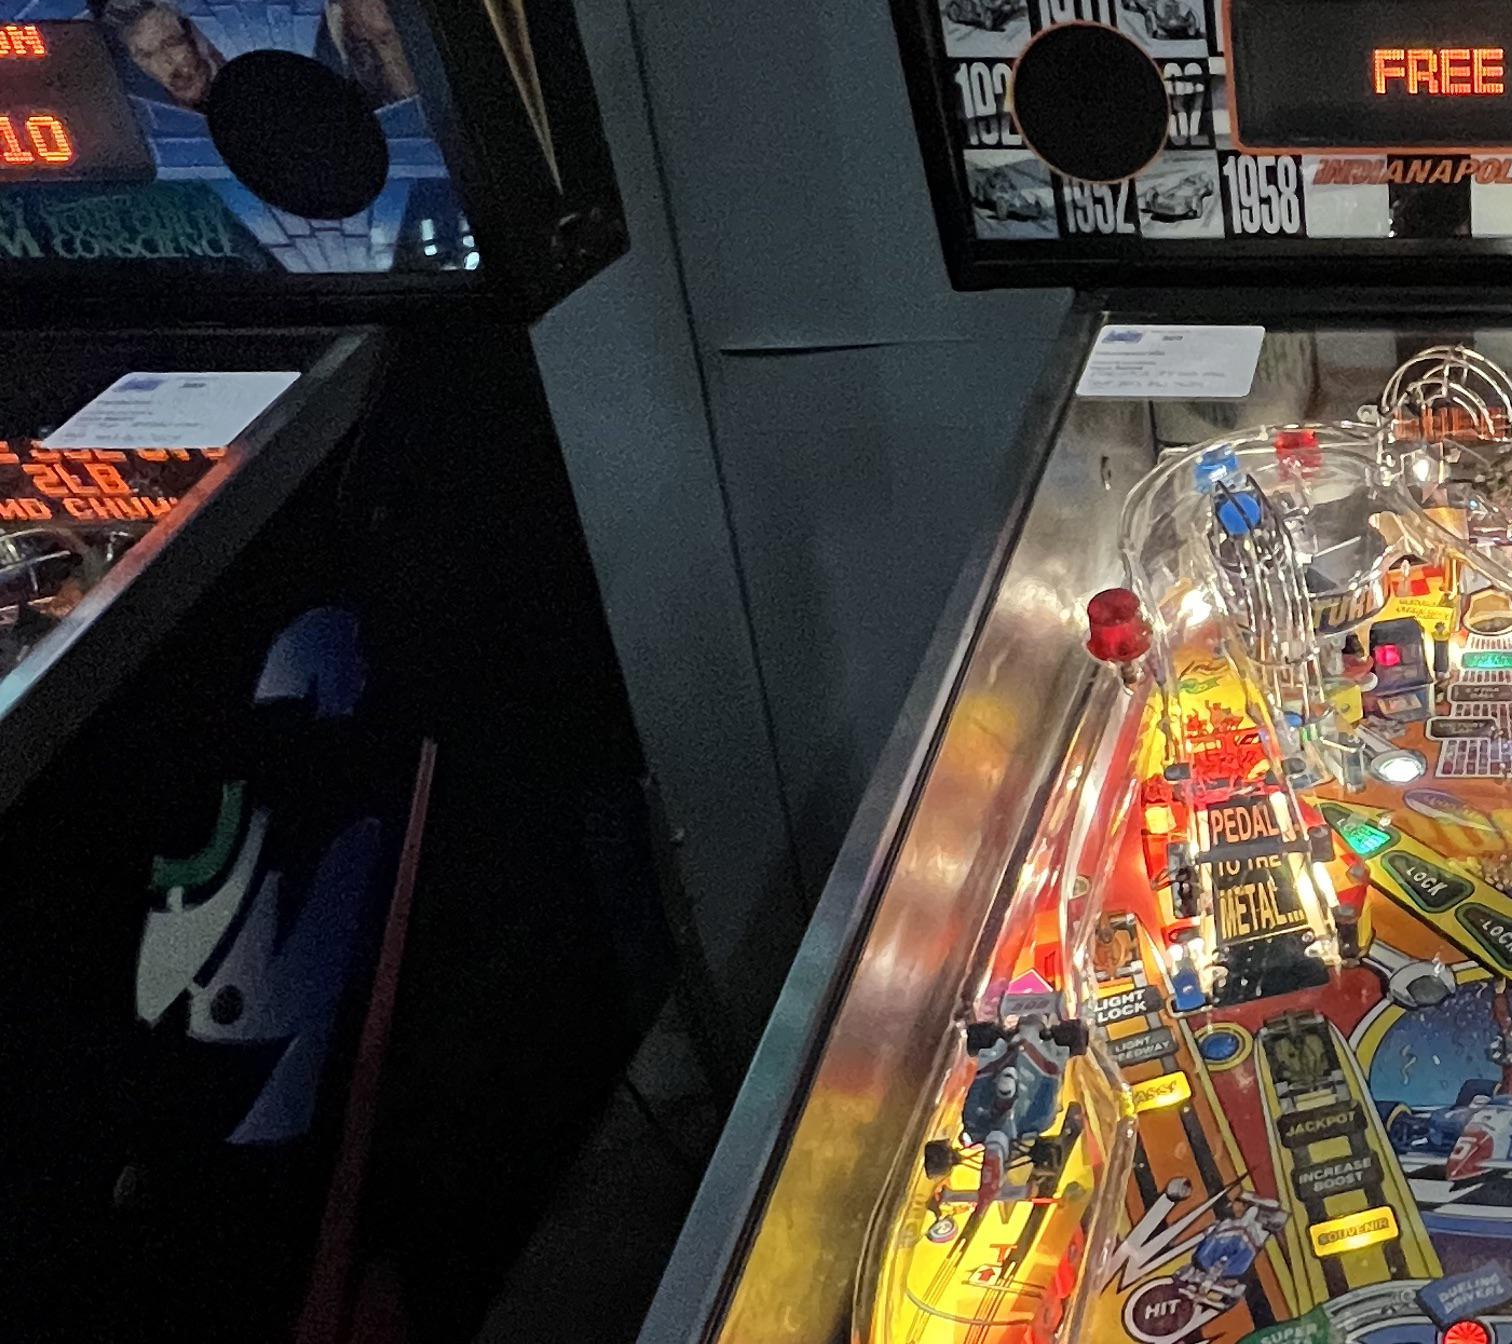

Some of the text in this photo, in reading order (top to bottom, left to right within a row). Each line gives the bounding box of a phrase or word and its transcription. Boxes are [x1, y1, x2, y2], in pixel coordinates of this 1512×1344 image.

[1374, 48, 1504, 95] FREE
[1223, 155, 1300, 235] 1958
[1405, 864, 1449, 898] LOCK
[1093, 988, 1147, 1013] LIGHT
[1097, 1000, 1148, 1024] LOCK
[1285, 1110, 1357, 1137] JACKPOT
[1299, 1157, 1373, 1186] INCREASE
[1312, 1169, 1367, 1193] BOOST
[1142, 1298, 1183, 1322] HIT
